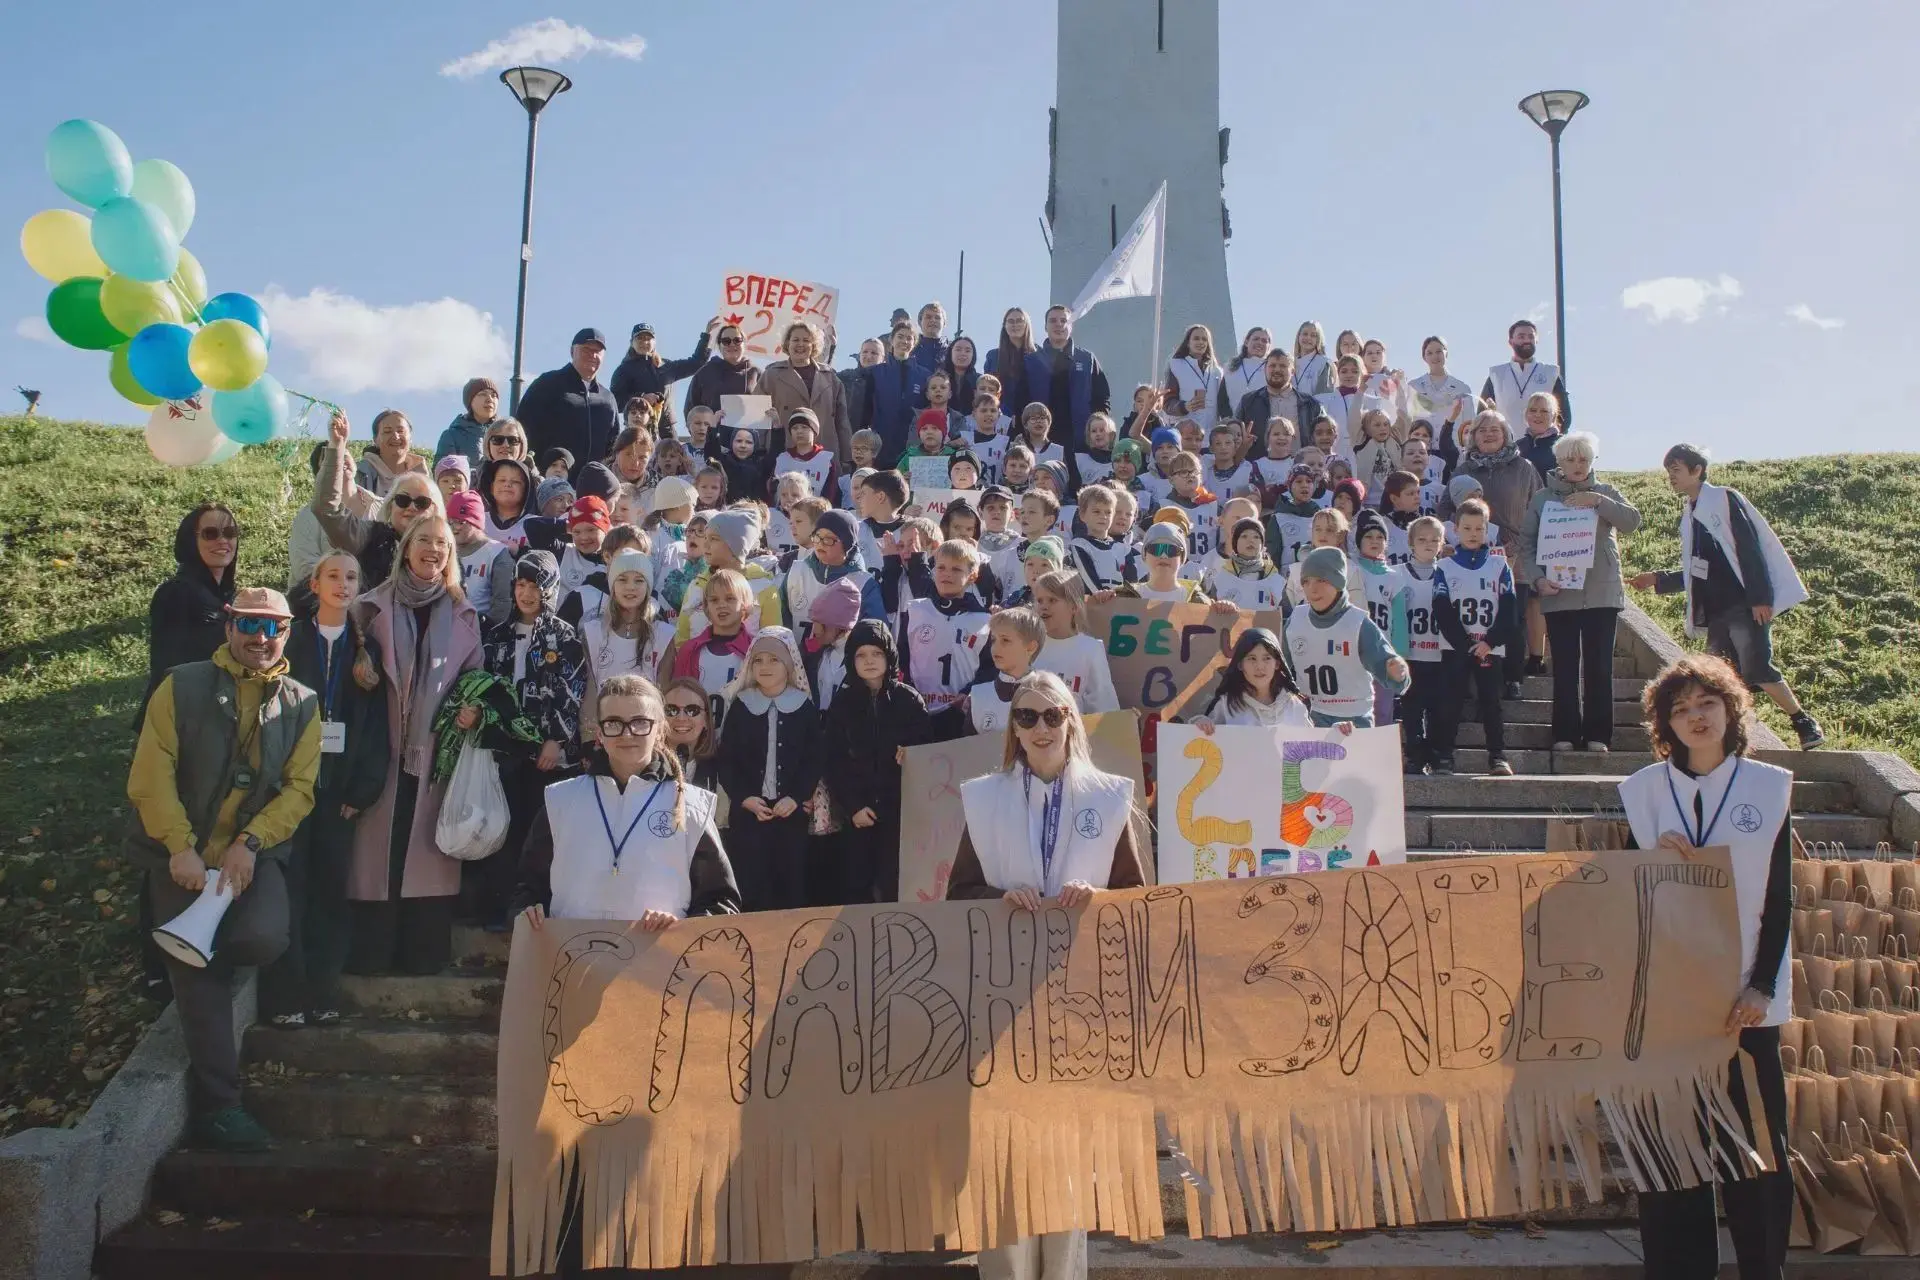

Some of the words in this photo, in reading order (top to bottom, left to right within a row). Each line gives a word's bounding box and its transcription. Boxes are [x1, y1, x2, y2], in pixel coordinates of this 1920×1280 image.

[725, 275, 832, 324] ВПЕРЕД
[1187, 532, 1209, 555] 13
[937, 653, 952, 686] 1
[1141, 666, 1178, 708] В
[1303, 664, 1339, 696] 10
[542, 886, 1205, 1127] СЛАВНЫЙ
[1237, 859, 1729, 1078] ЗАБЕГ
